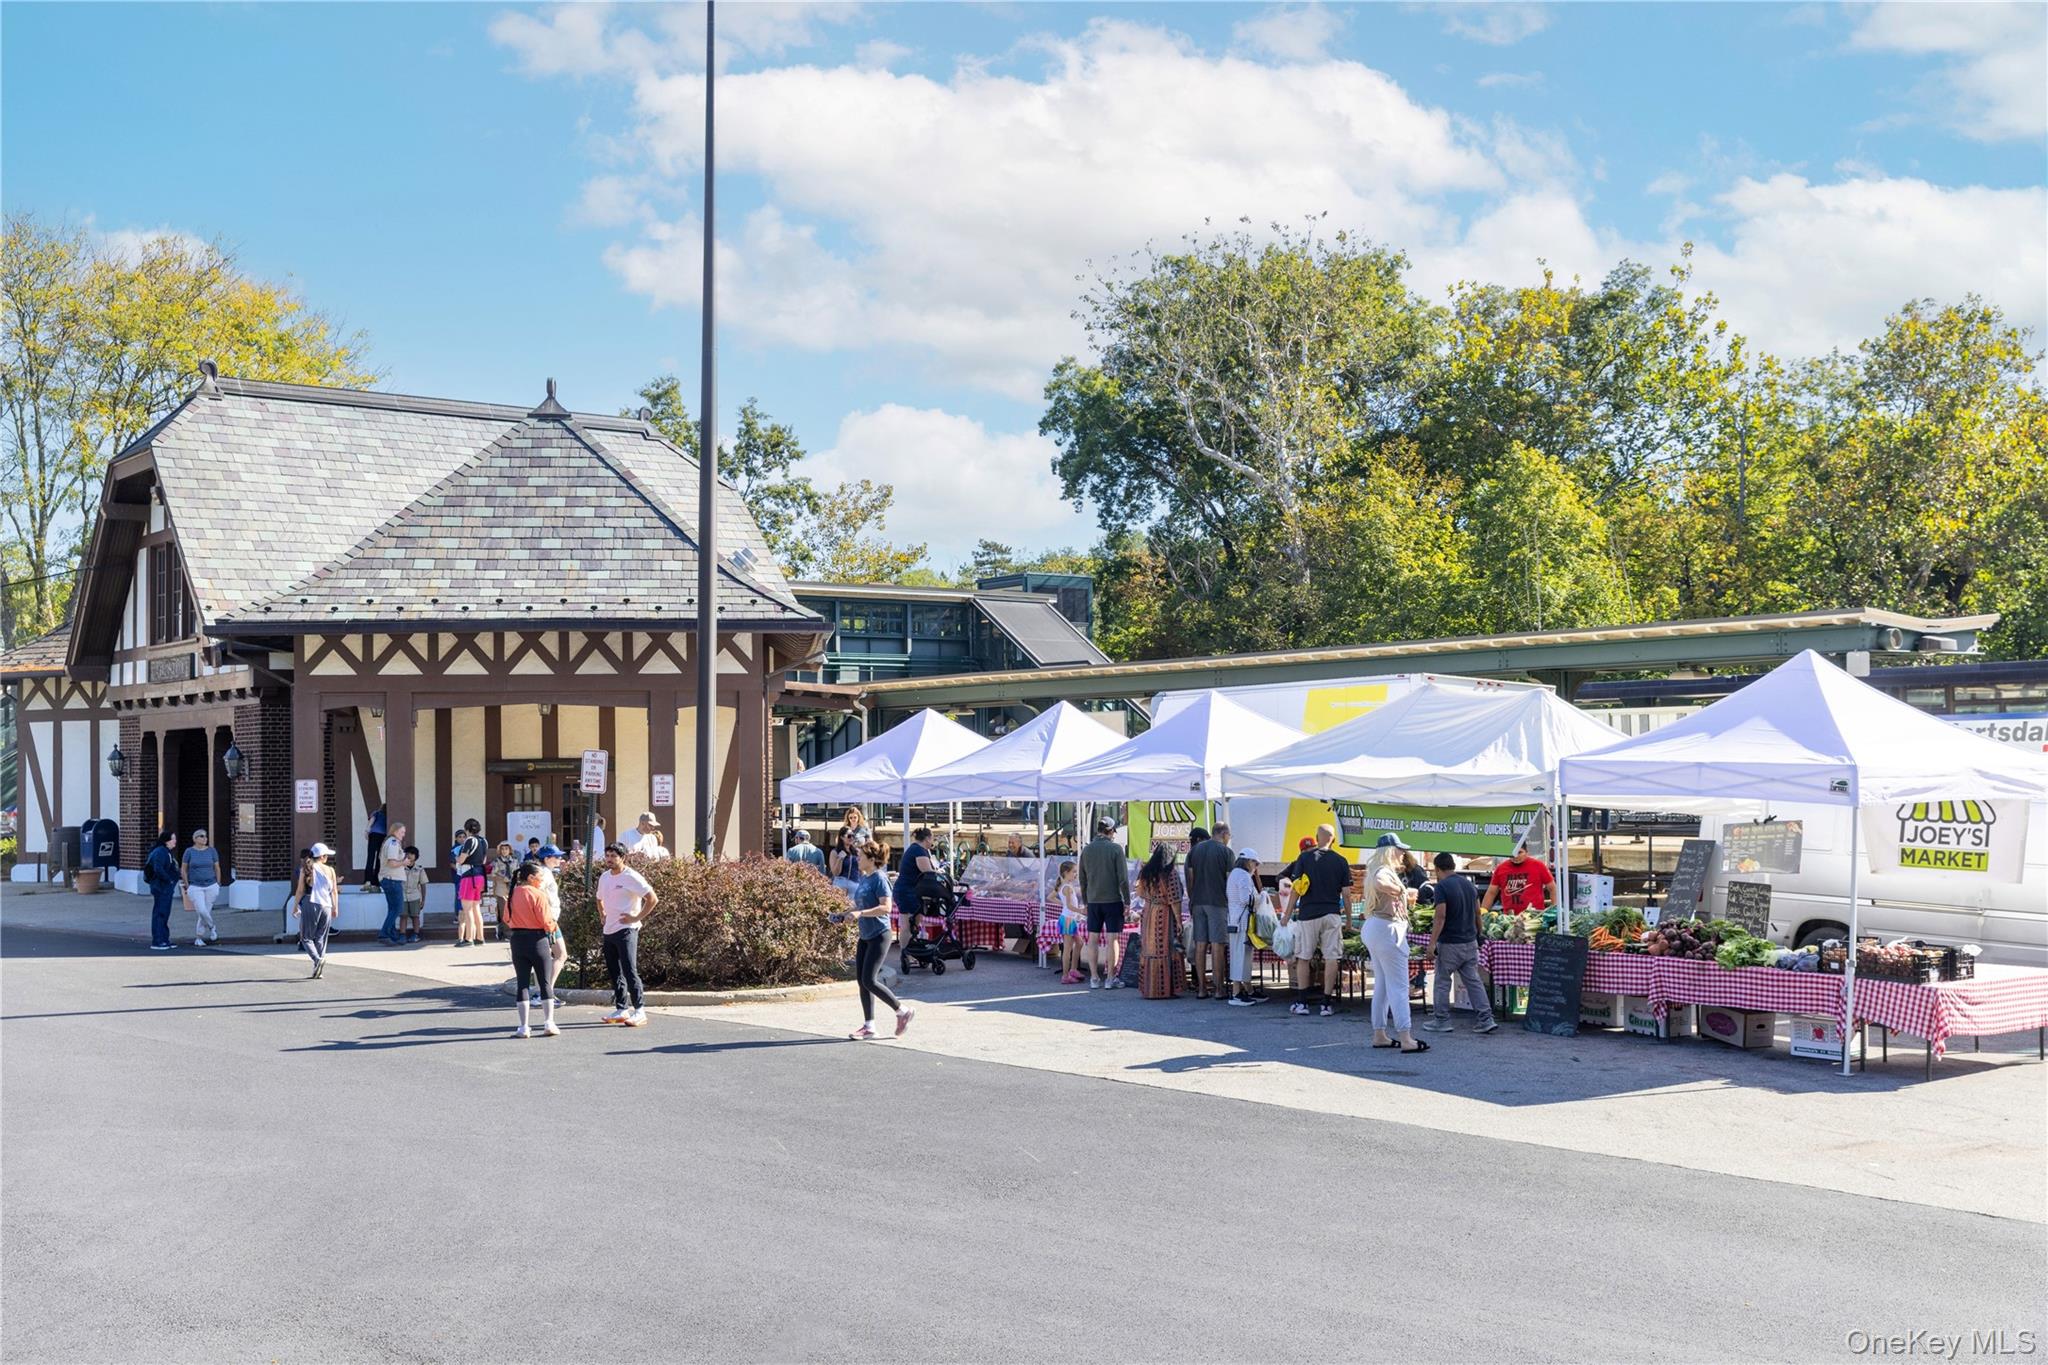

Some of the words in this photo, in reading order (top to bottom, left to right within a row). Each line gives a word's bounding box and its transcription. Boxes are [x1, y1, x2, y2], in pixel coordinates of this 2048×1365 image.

[1155, 825, 1191, 837] JOEY'S
[1363, 818, 1404, 831] MOZZARELLA
[1410, 820, 1448, 833] CRABCAKES
[1453, 822, 1479, 834] RAVIOLI
[1483, 823, 1511, 836] QUICHES
[1906, 825, 1984, 847] JOEY'S
[1900, 847, 1986, 868] MARKET
